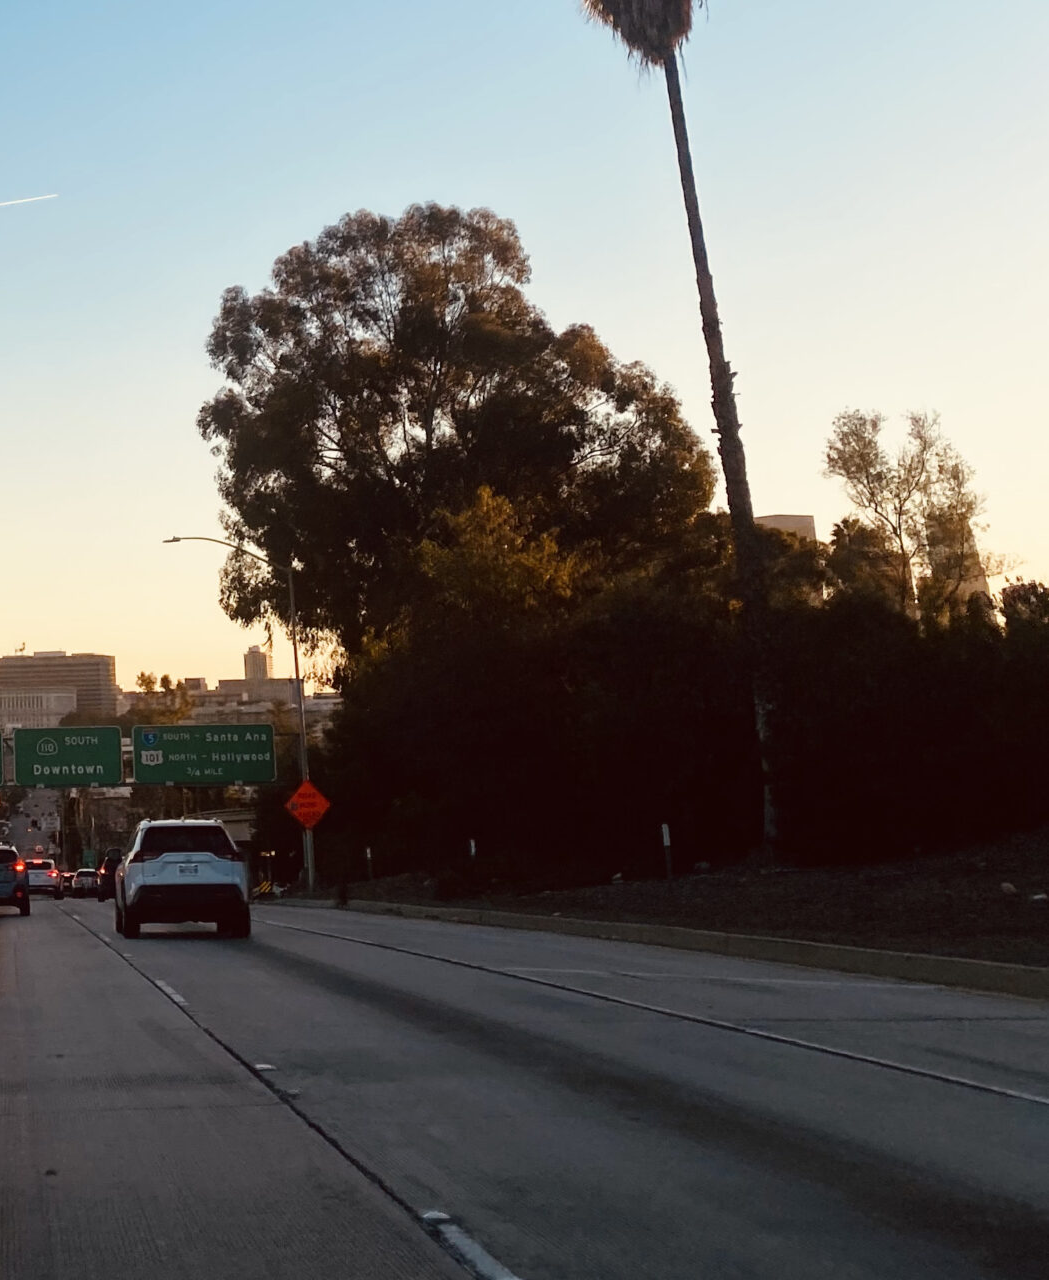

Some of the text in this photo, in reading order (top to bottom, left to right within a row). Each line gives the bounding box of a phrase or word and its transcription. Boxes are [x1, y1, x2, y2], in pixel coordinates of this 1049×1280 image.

[205, 732, 238, 741] Santa
[245, 732, 267, 741] Ana
[41, 736, 98, 752] 110 SOUTH
[145, 753, 160, 762] 101
[211, 752, 270, 763] Hollywood
[33, 764, 104, 775] Downtown
